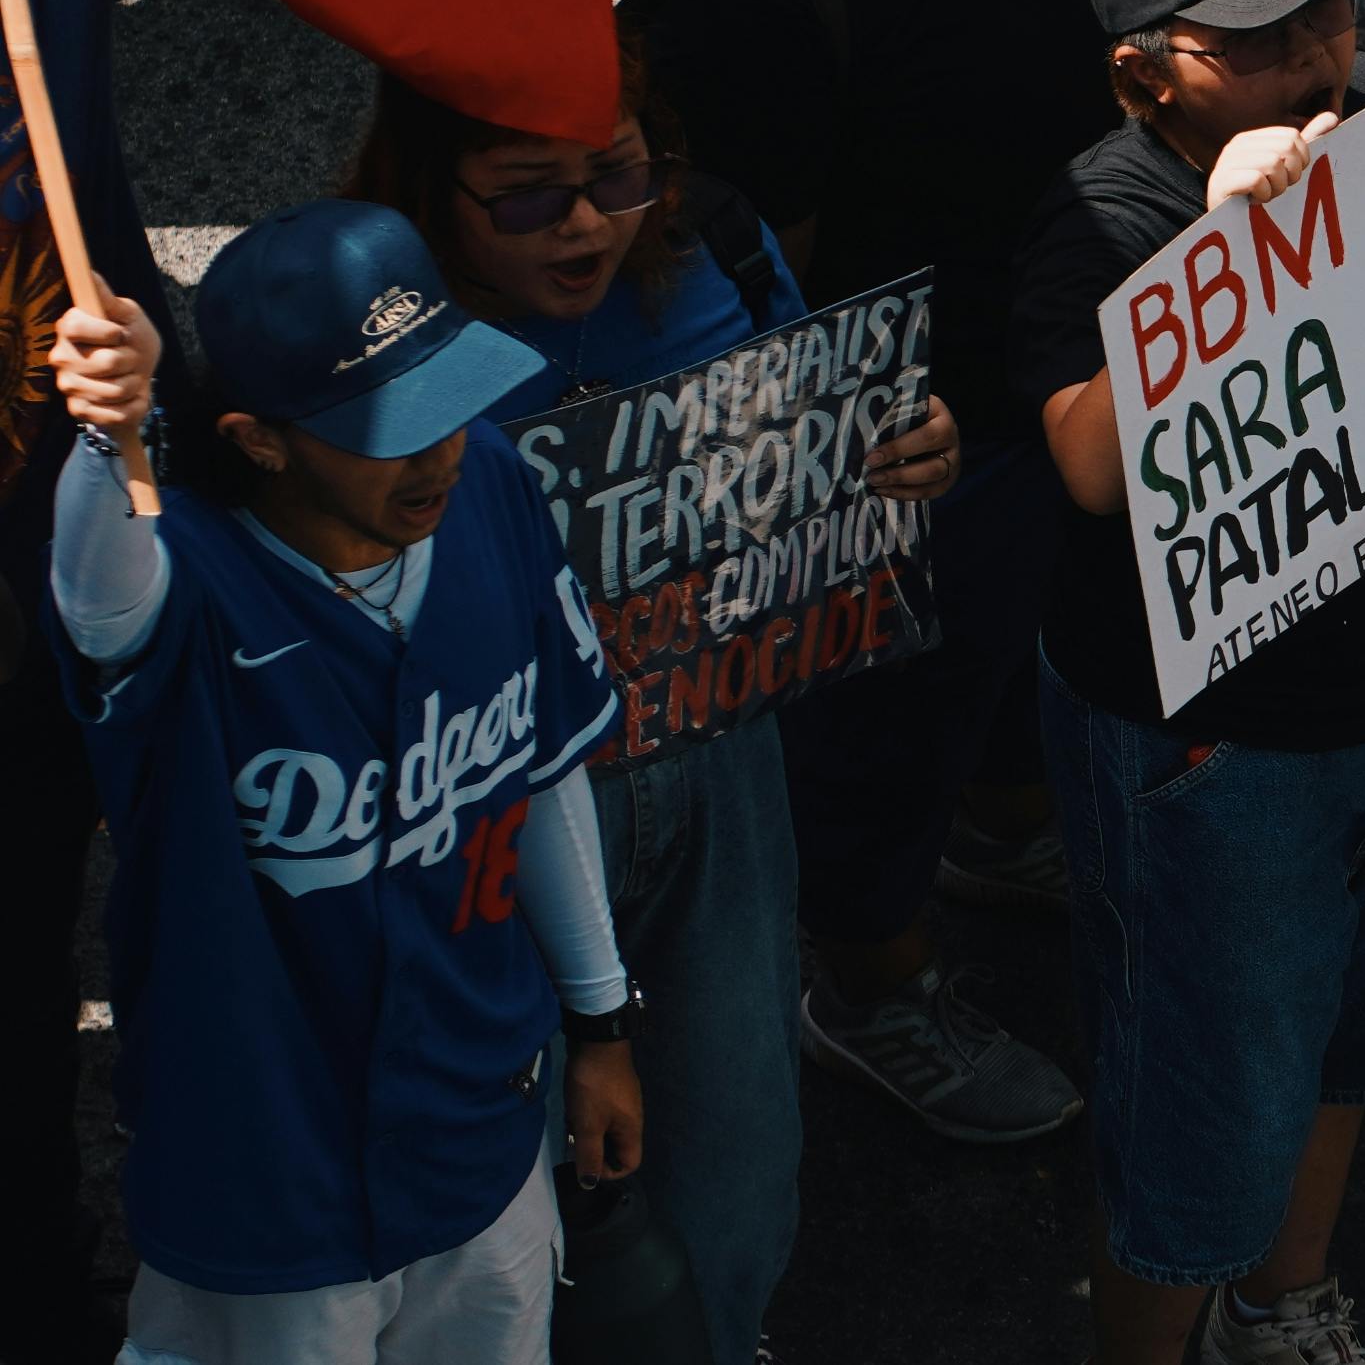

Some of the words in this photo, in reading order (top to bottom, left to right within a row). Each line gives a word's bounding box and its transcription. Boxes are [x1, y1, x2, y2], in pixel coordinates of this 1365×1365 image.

[606, 285, 935, 475] IMPERIALIST
[1129, 154, 1345, 411] BBM
[586, 363, 930, 599] TERRORIST
[1141, 319, 1346, 540] SARA
[587, 566, 903, 765] ENOCIDE
[1206, 563, 1339, 685] ATENEO
